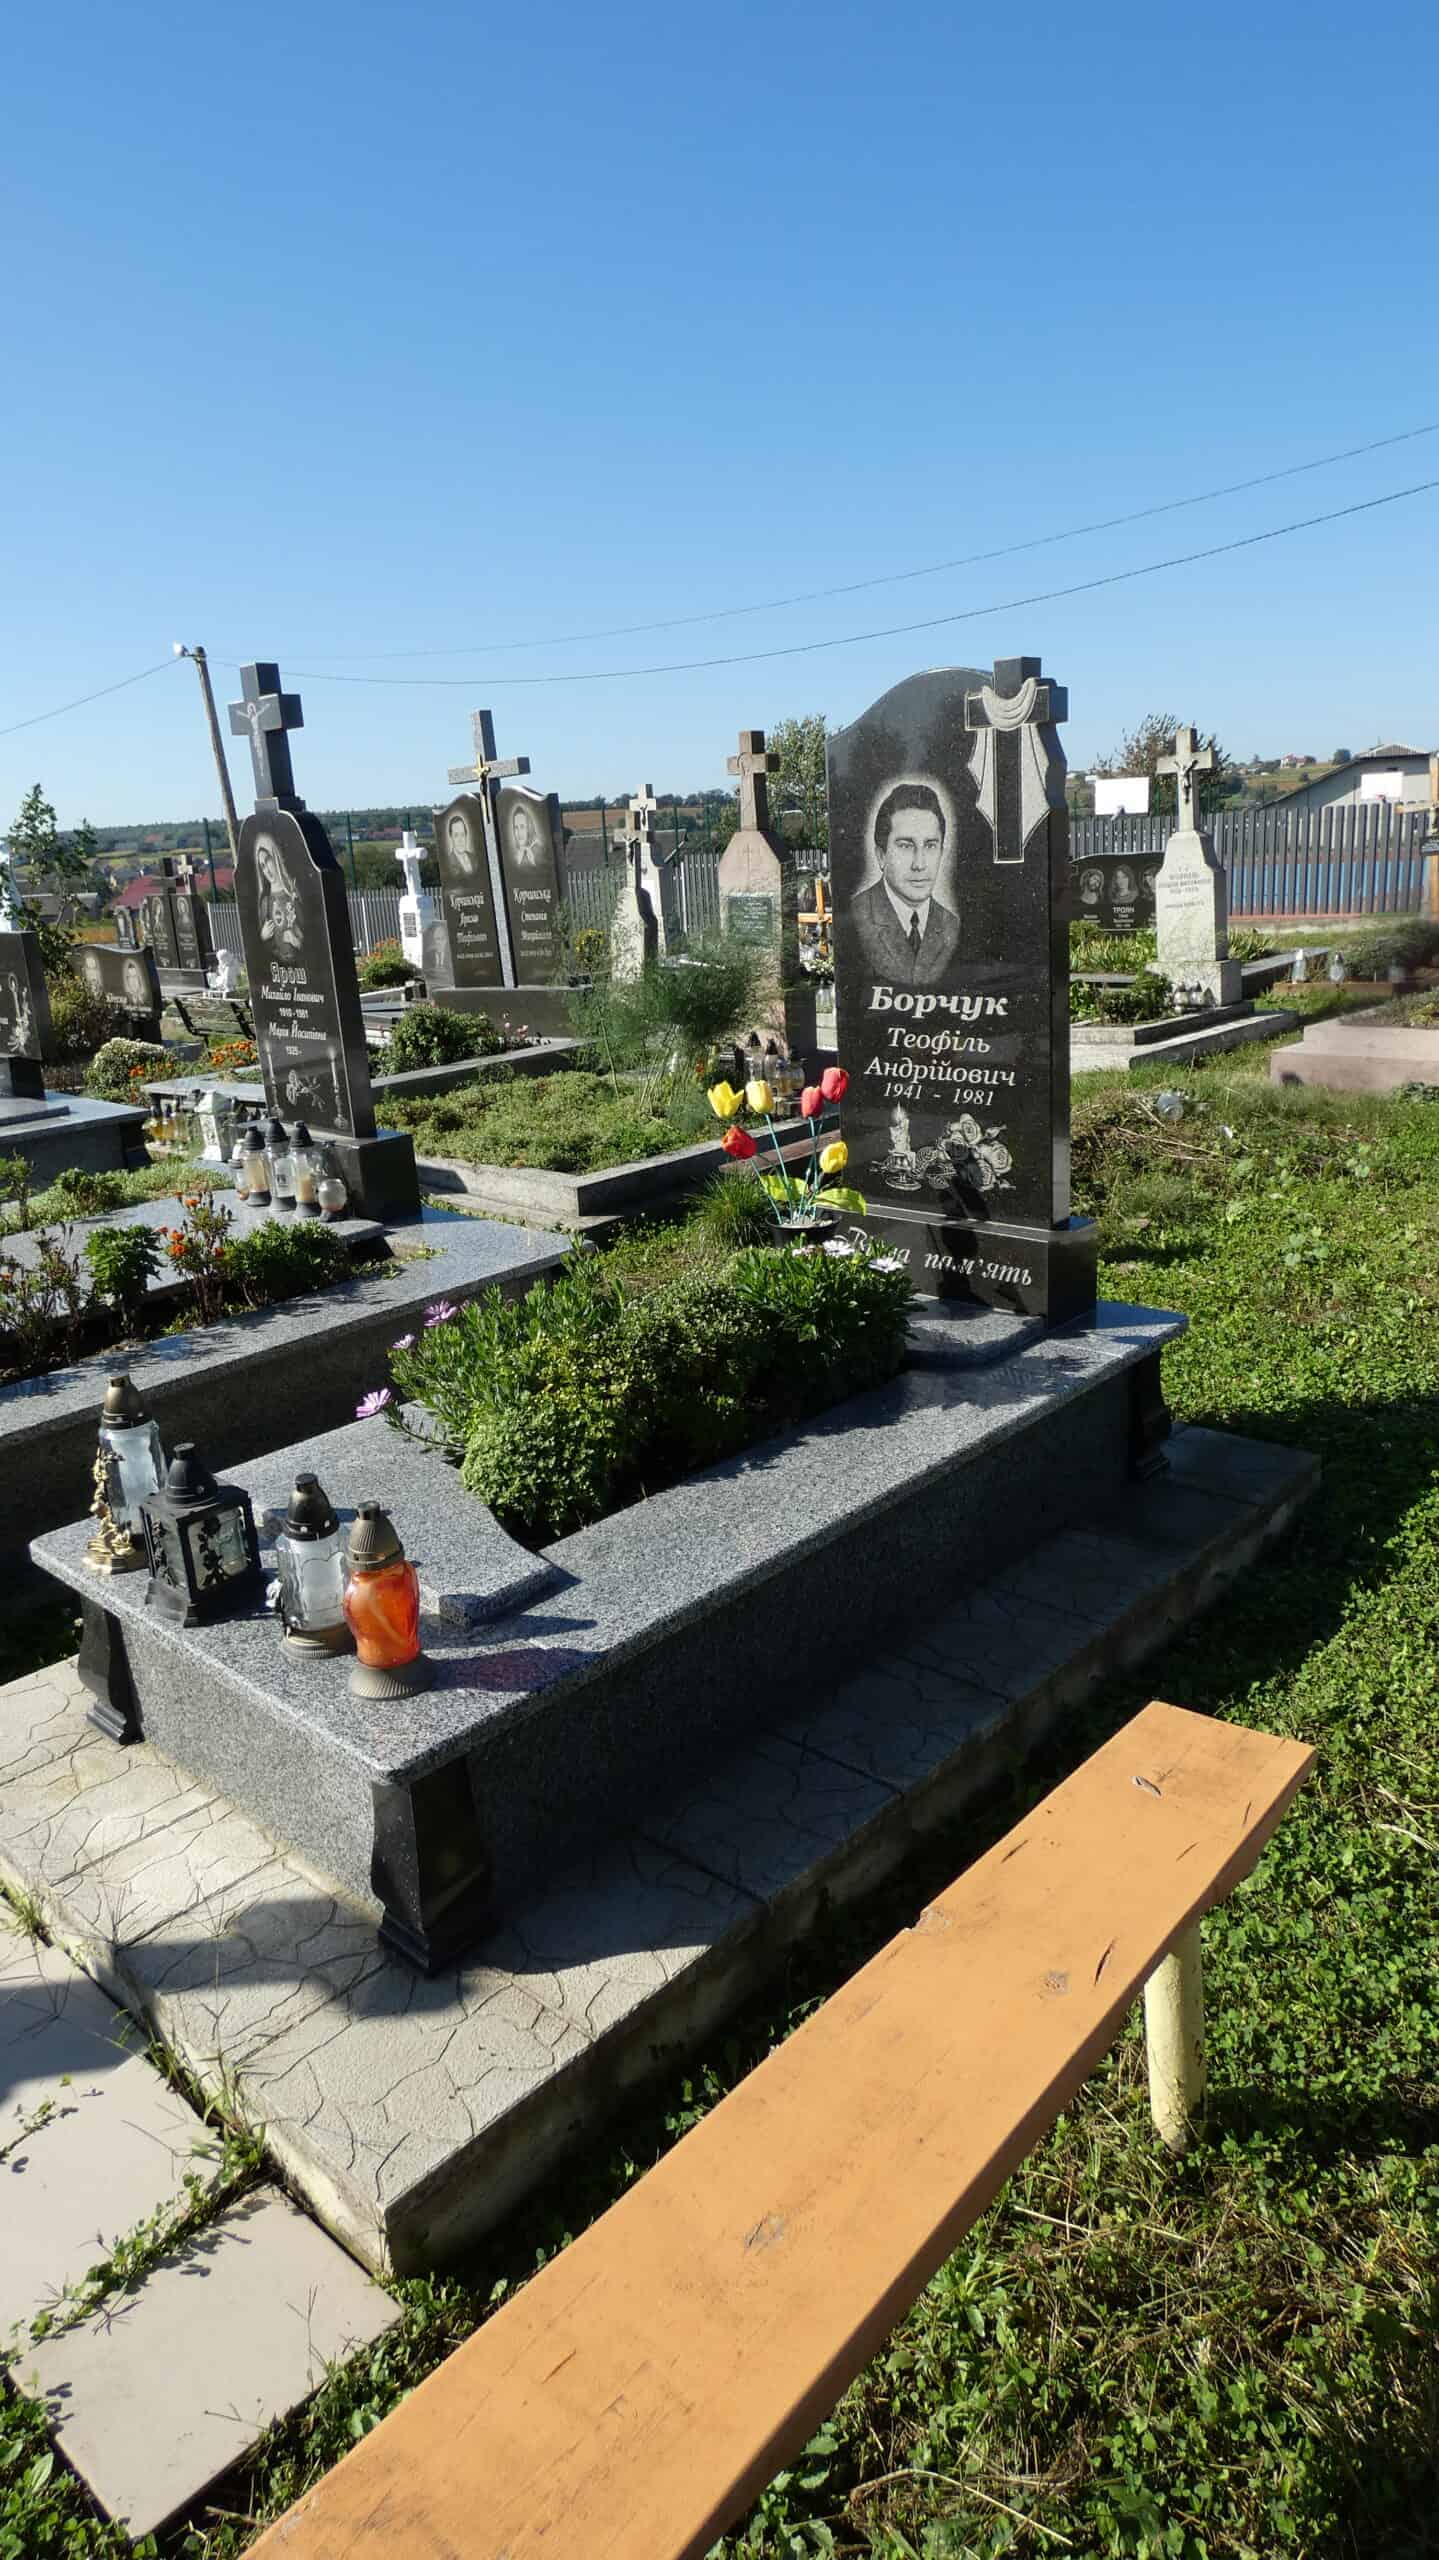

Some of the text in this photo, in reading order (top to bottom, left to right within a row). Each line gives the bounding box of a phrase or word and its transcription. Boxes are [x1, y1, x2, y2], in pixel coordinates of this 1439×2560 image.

[270, 961, 307, 987] Ярош
[868, 985, 1008, 1021] Борчук
[887, 1026, 992, 1054] Теофіль
[864, 1056, 1017, 1087] Андрійович
[883, 1082, 923, 1100] 1941
[952, 1088, 995, 1106] 1981
